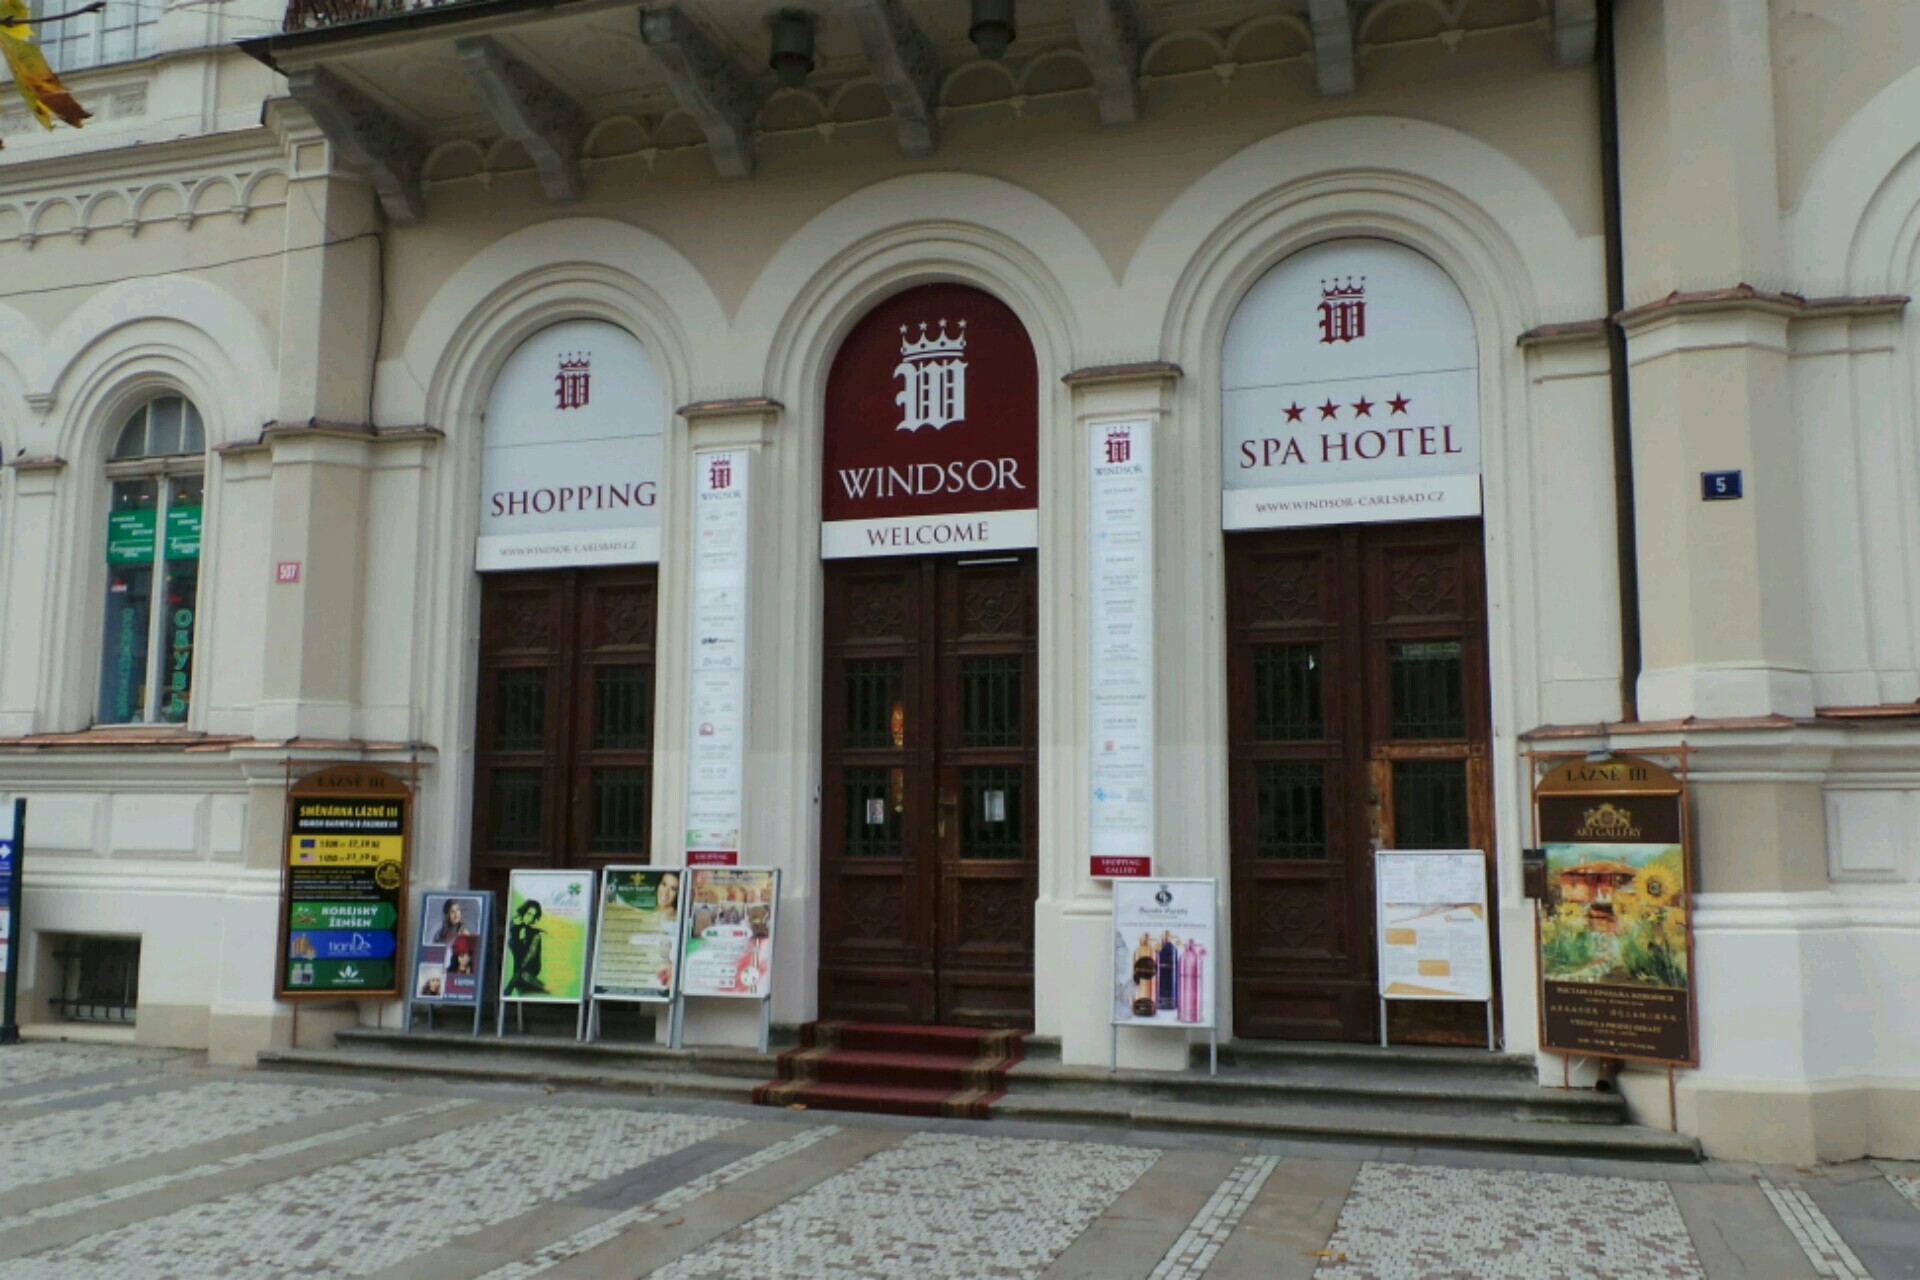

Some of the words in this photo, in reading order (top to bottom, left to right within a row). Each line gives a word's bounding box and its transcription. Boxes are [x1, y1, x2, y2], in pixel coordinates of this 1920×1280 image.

[1240, 436, 1308, 469] SPA
[1319, 424, 1463, 463] HOTEL
[838, 458, 1026, 499] WINDSOR
[1094, 465, 1143, 476] WINDSOR
[1716, 477, 1727, 493] 5
[491, 481, 657, 517] SHOPPING
[1255, 491, 1445, 513] WWW.WINDSOR-CARLSBAD.CZ
[867, 521, 989, 547] WELCOME
[1566, 766, 1621, 782] LÁZNĚ
[1629, 768, 1648, 781] III
[1576, 827, 1594, 837] ART
[1595, 827, 1642, 838] GALLERY
[321, 904, 378, 916] KOREJSKÝ
[328, 915, 372, 927] ŽENŠEN
